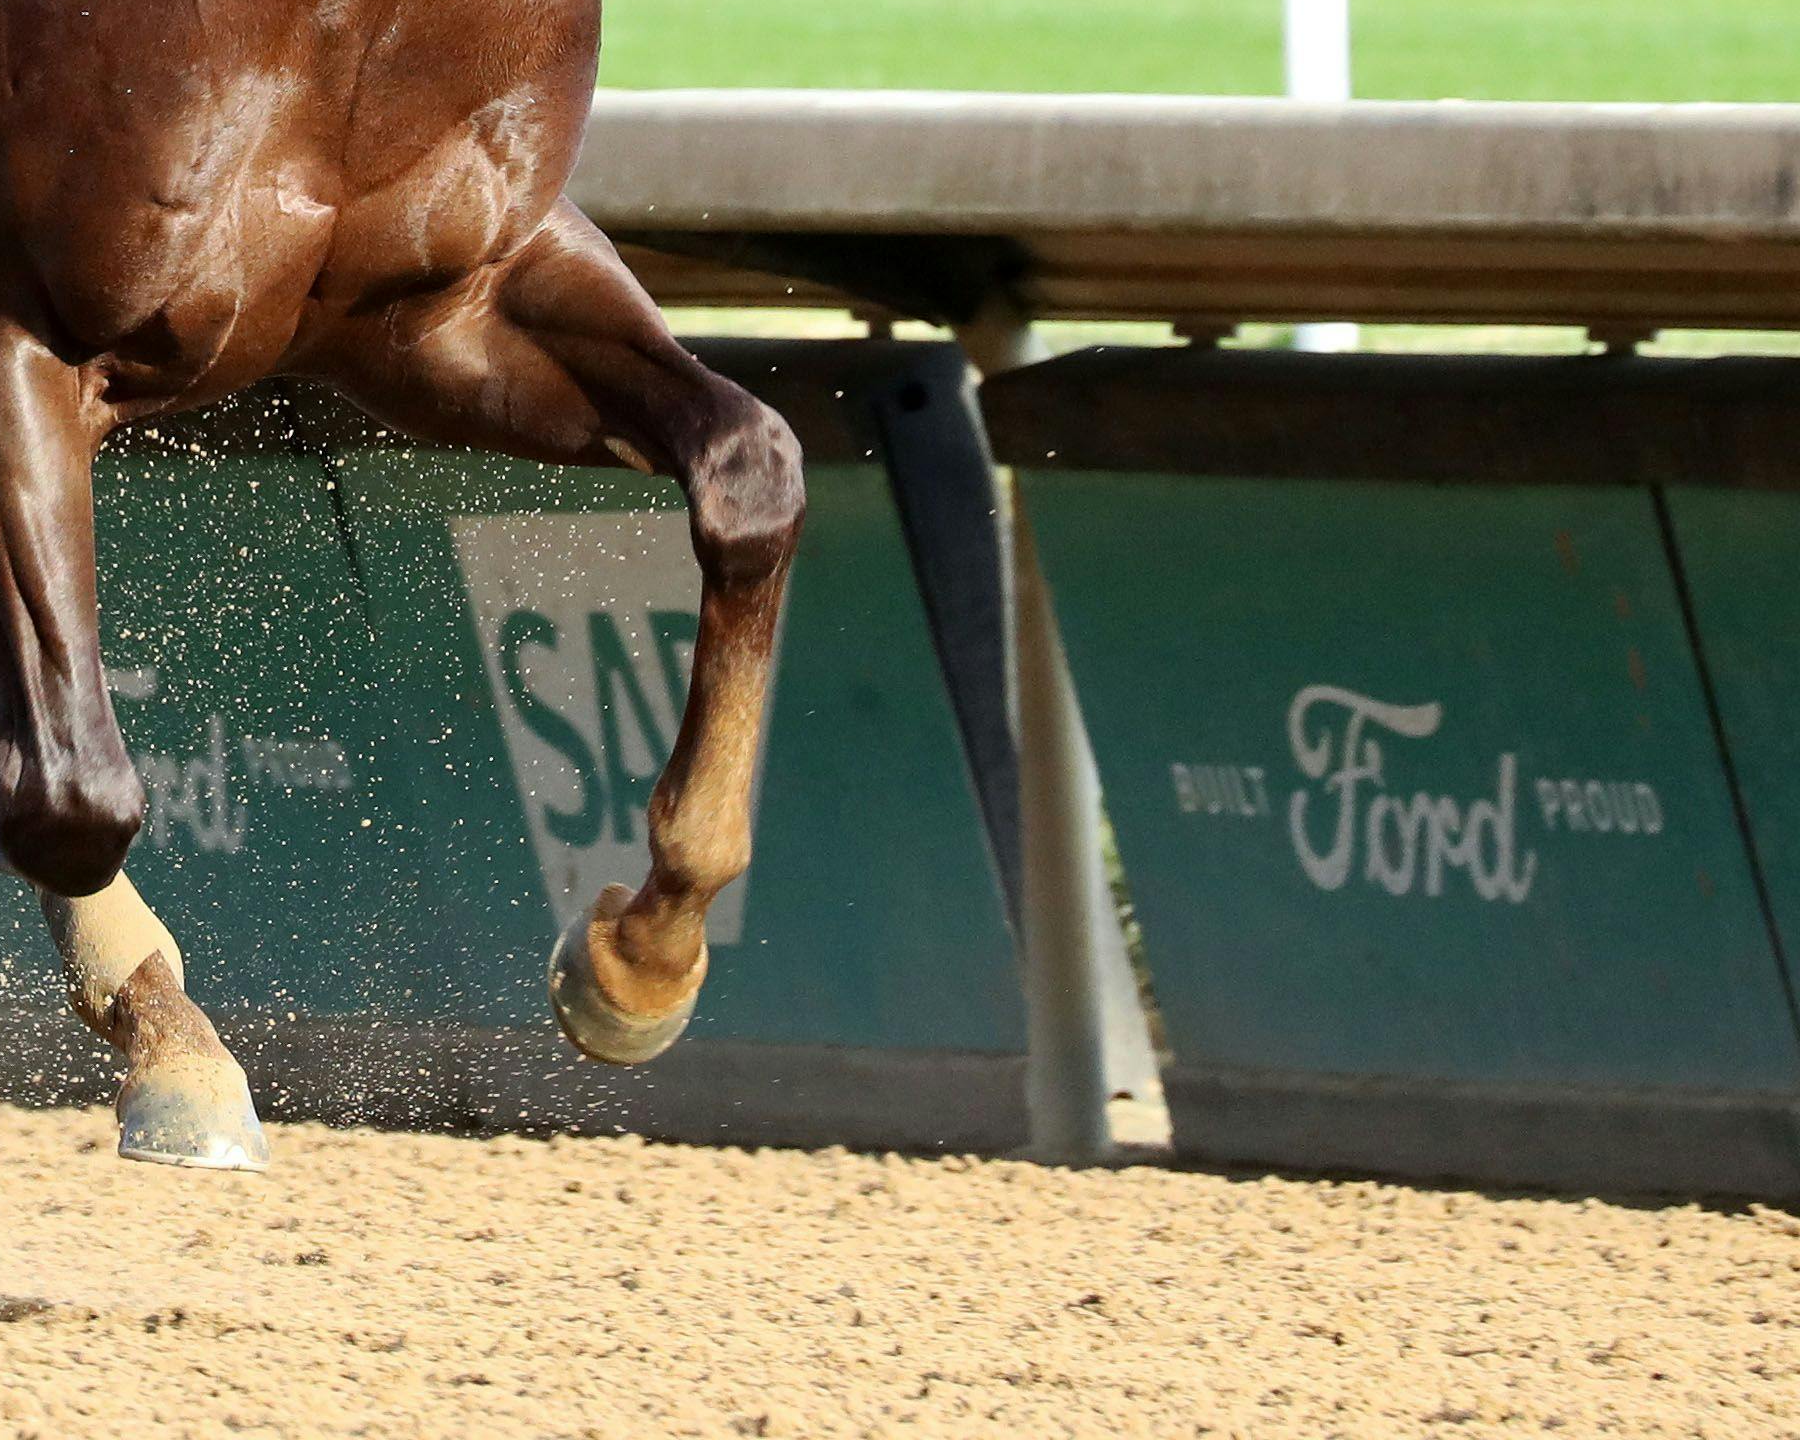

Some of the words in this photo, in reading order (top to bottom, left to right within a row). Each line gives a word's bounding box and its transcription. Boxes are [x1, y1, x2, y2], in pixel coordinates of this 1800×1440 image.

[1172, 763, 1269, 816] BUILT
[1288, 684, 1537, 903] Ford
[1535, 778, 1665, 834] PROUD
